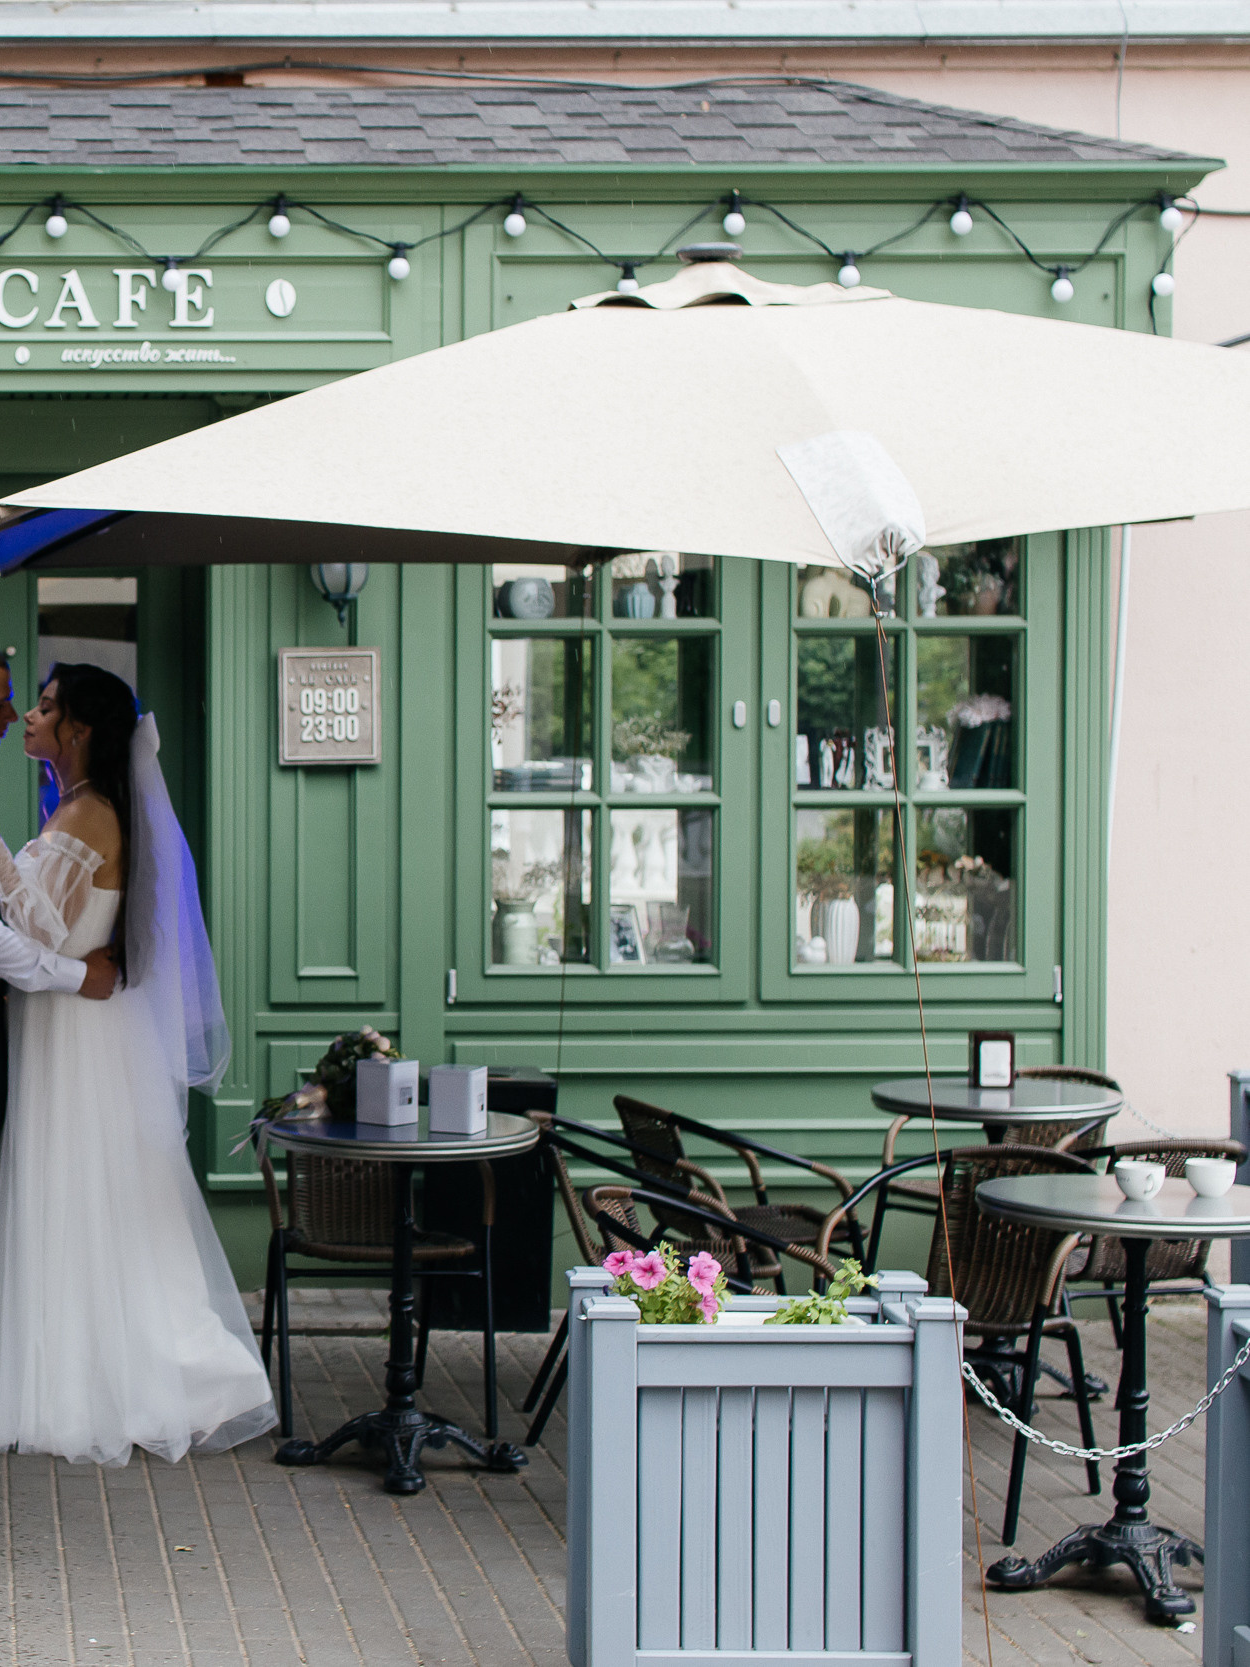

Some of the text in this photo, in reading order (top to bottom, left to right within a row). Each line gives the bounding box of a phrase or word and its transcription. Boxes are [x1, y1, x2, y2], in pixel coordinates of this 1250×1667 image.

[61, 341, 162, 369] искусство
[300, 687, 359, 715] 09:00
[300, 715, 359, 743] 23:00
